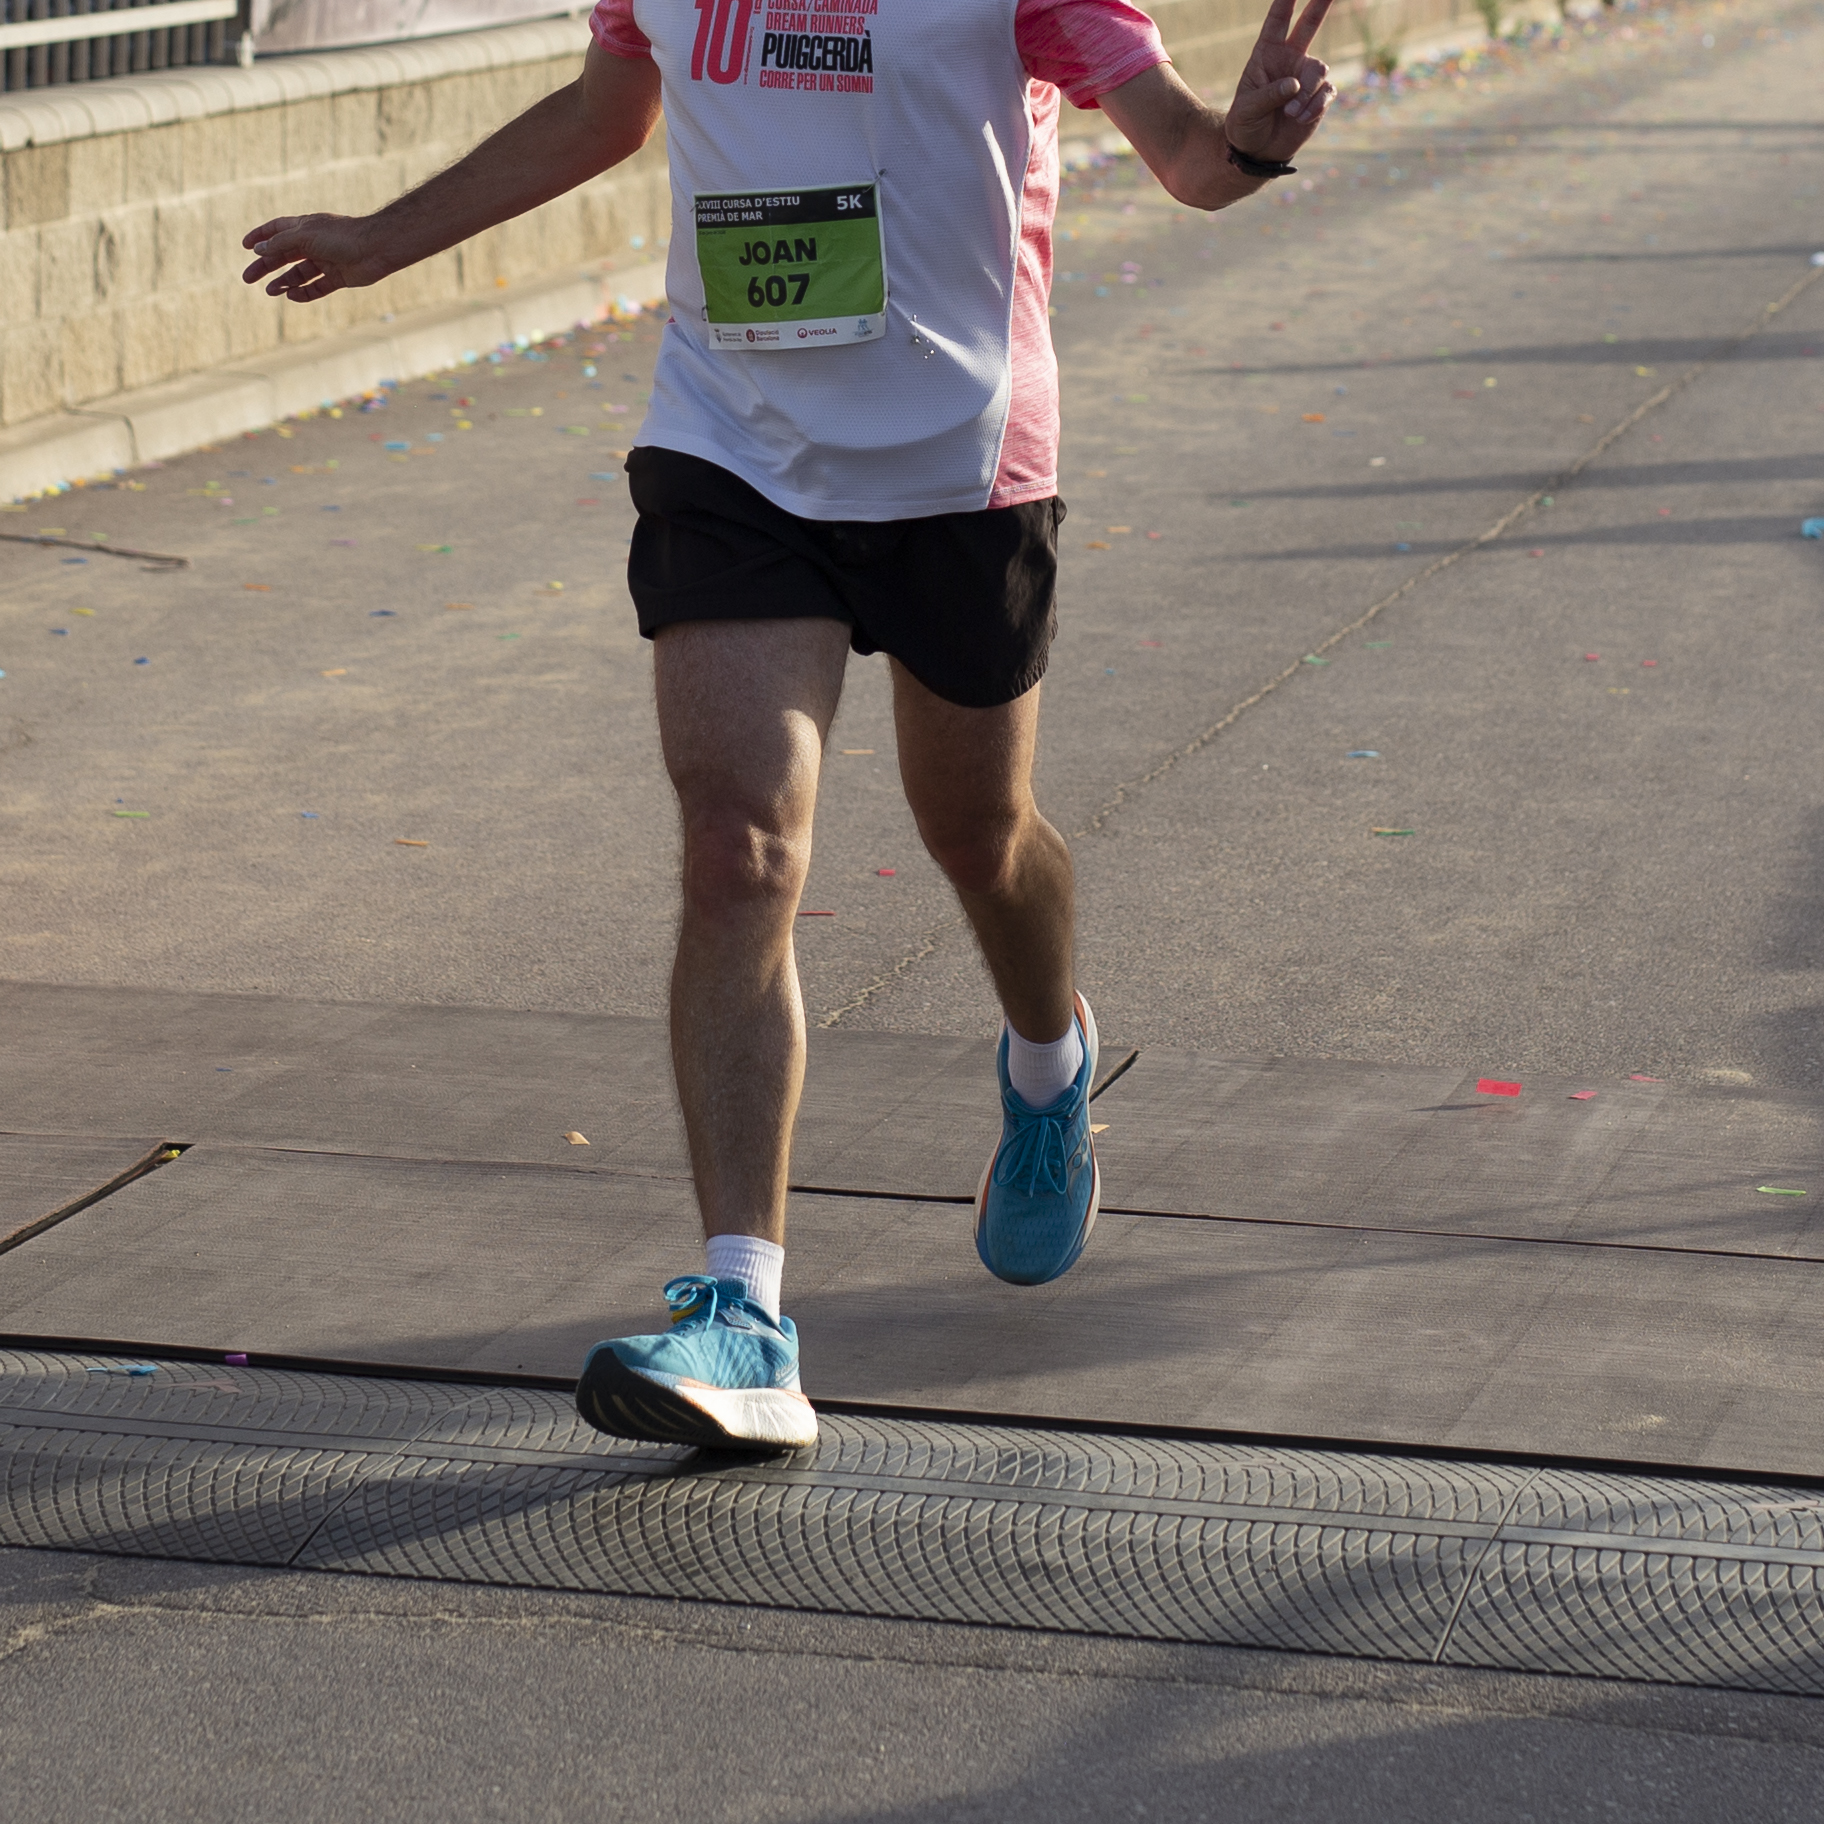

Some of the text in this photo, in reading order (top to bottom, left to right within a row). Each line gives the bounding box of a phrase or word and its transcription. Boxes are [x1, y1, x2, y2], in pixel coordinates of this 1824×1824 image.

[765, 11, 865, 35] DREAM RUNNERS
[761, 29, 873, 73] PUIGCERDÀ
[759, 69, 874, 93] CORRE PER UN SOMNI
[722, 198, 753, 210] CURSA
[754, 196, 801, 208] D'ESTIU
[836, 194, 864, 211] 5K
[697, 210, 764, 223] PREMIÀ DE MAR
[738, 237, 818, 266] JOAN
[747, 272, 811, 308] 607
[808, 327, 838, 336] VEOLIA
